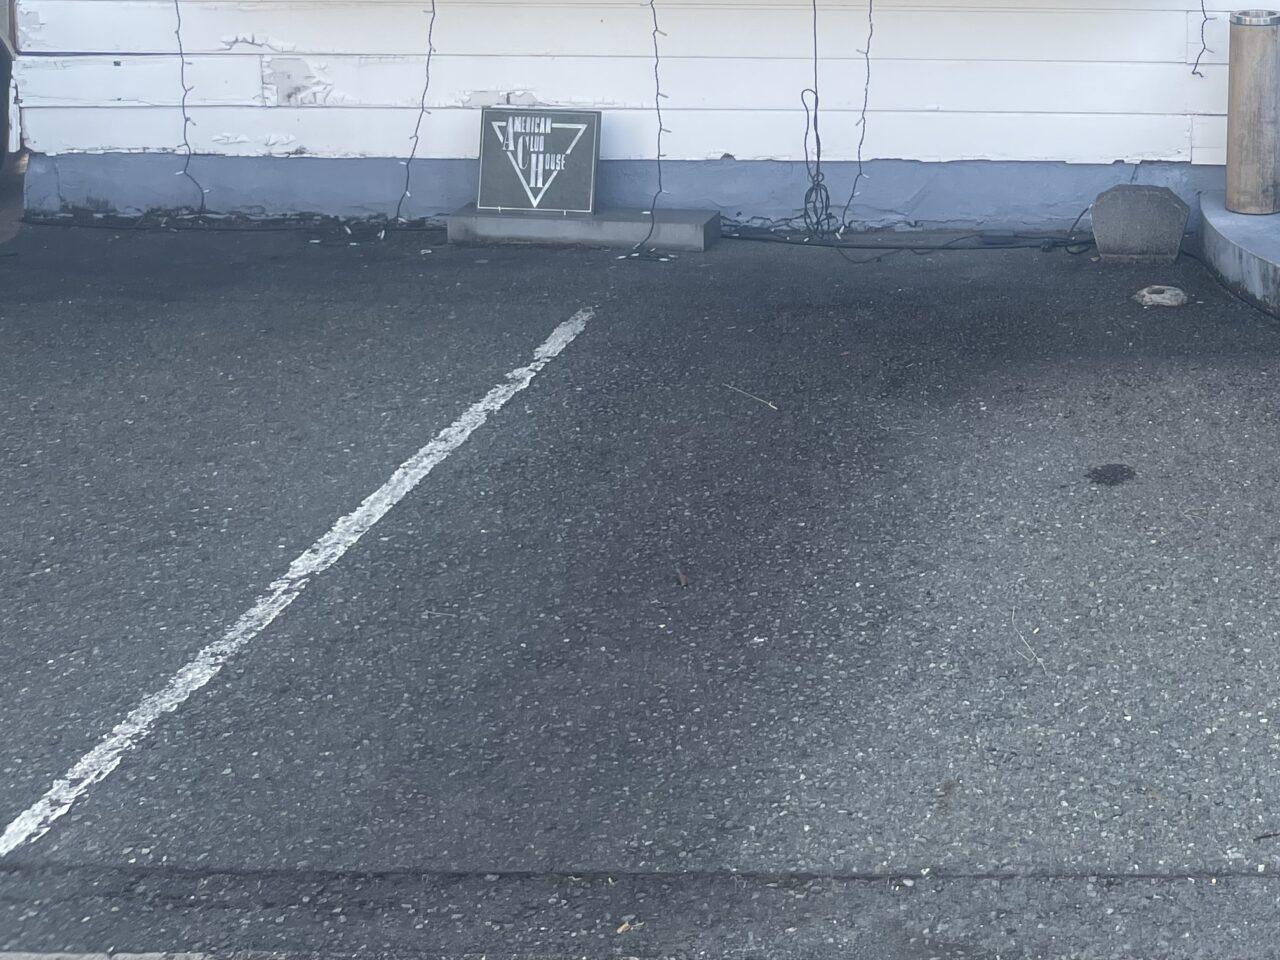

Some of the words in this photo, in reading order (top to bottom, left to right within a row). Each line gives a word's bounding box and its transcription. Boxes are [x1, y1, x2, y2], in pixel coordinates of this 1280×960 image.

[502, 116, 552, 151] AMERICAN
[517, 134, 545, 170] CLUB
[529, 153, 566, 188] HOUSE
